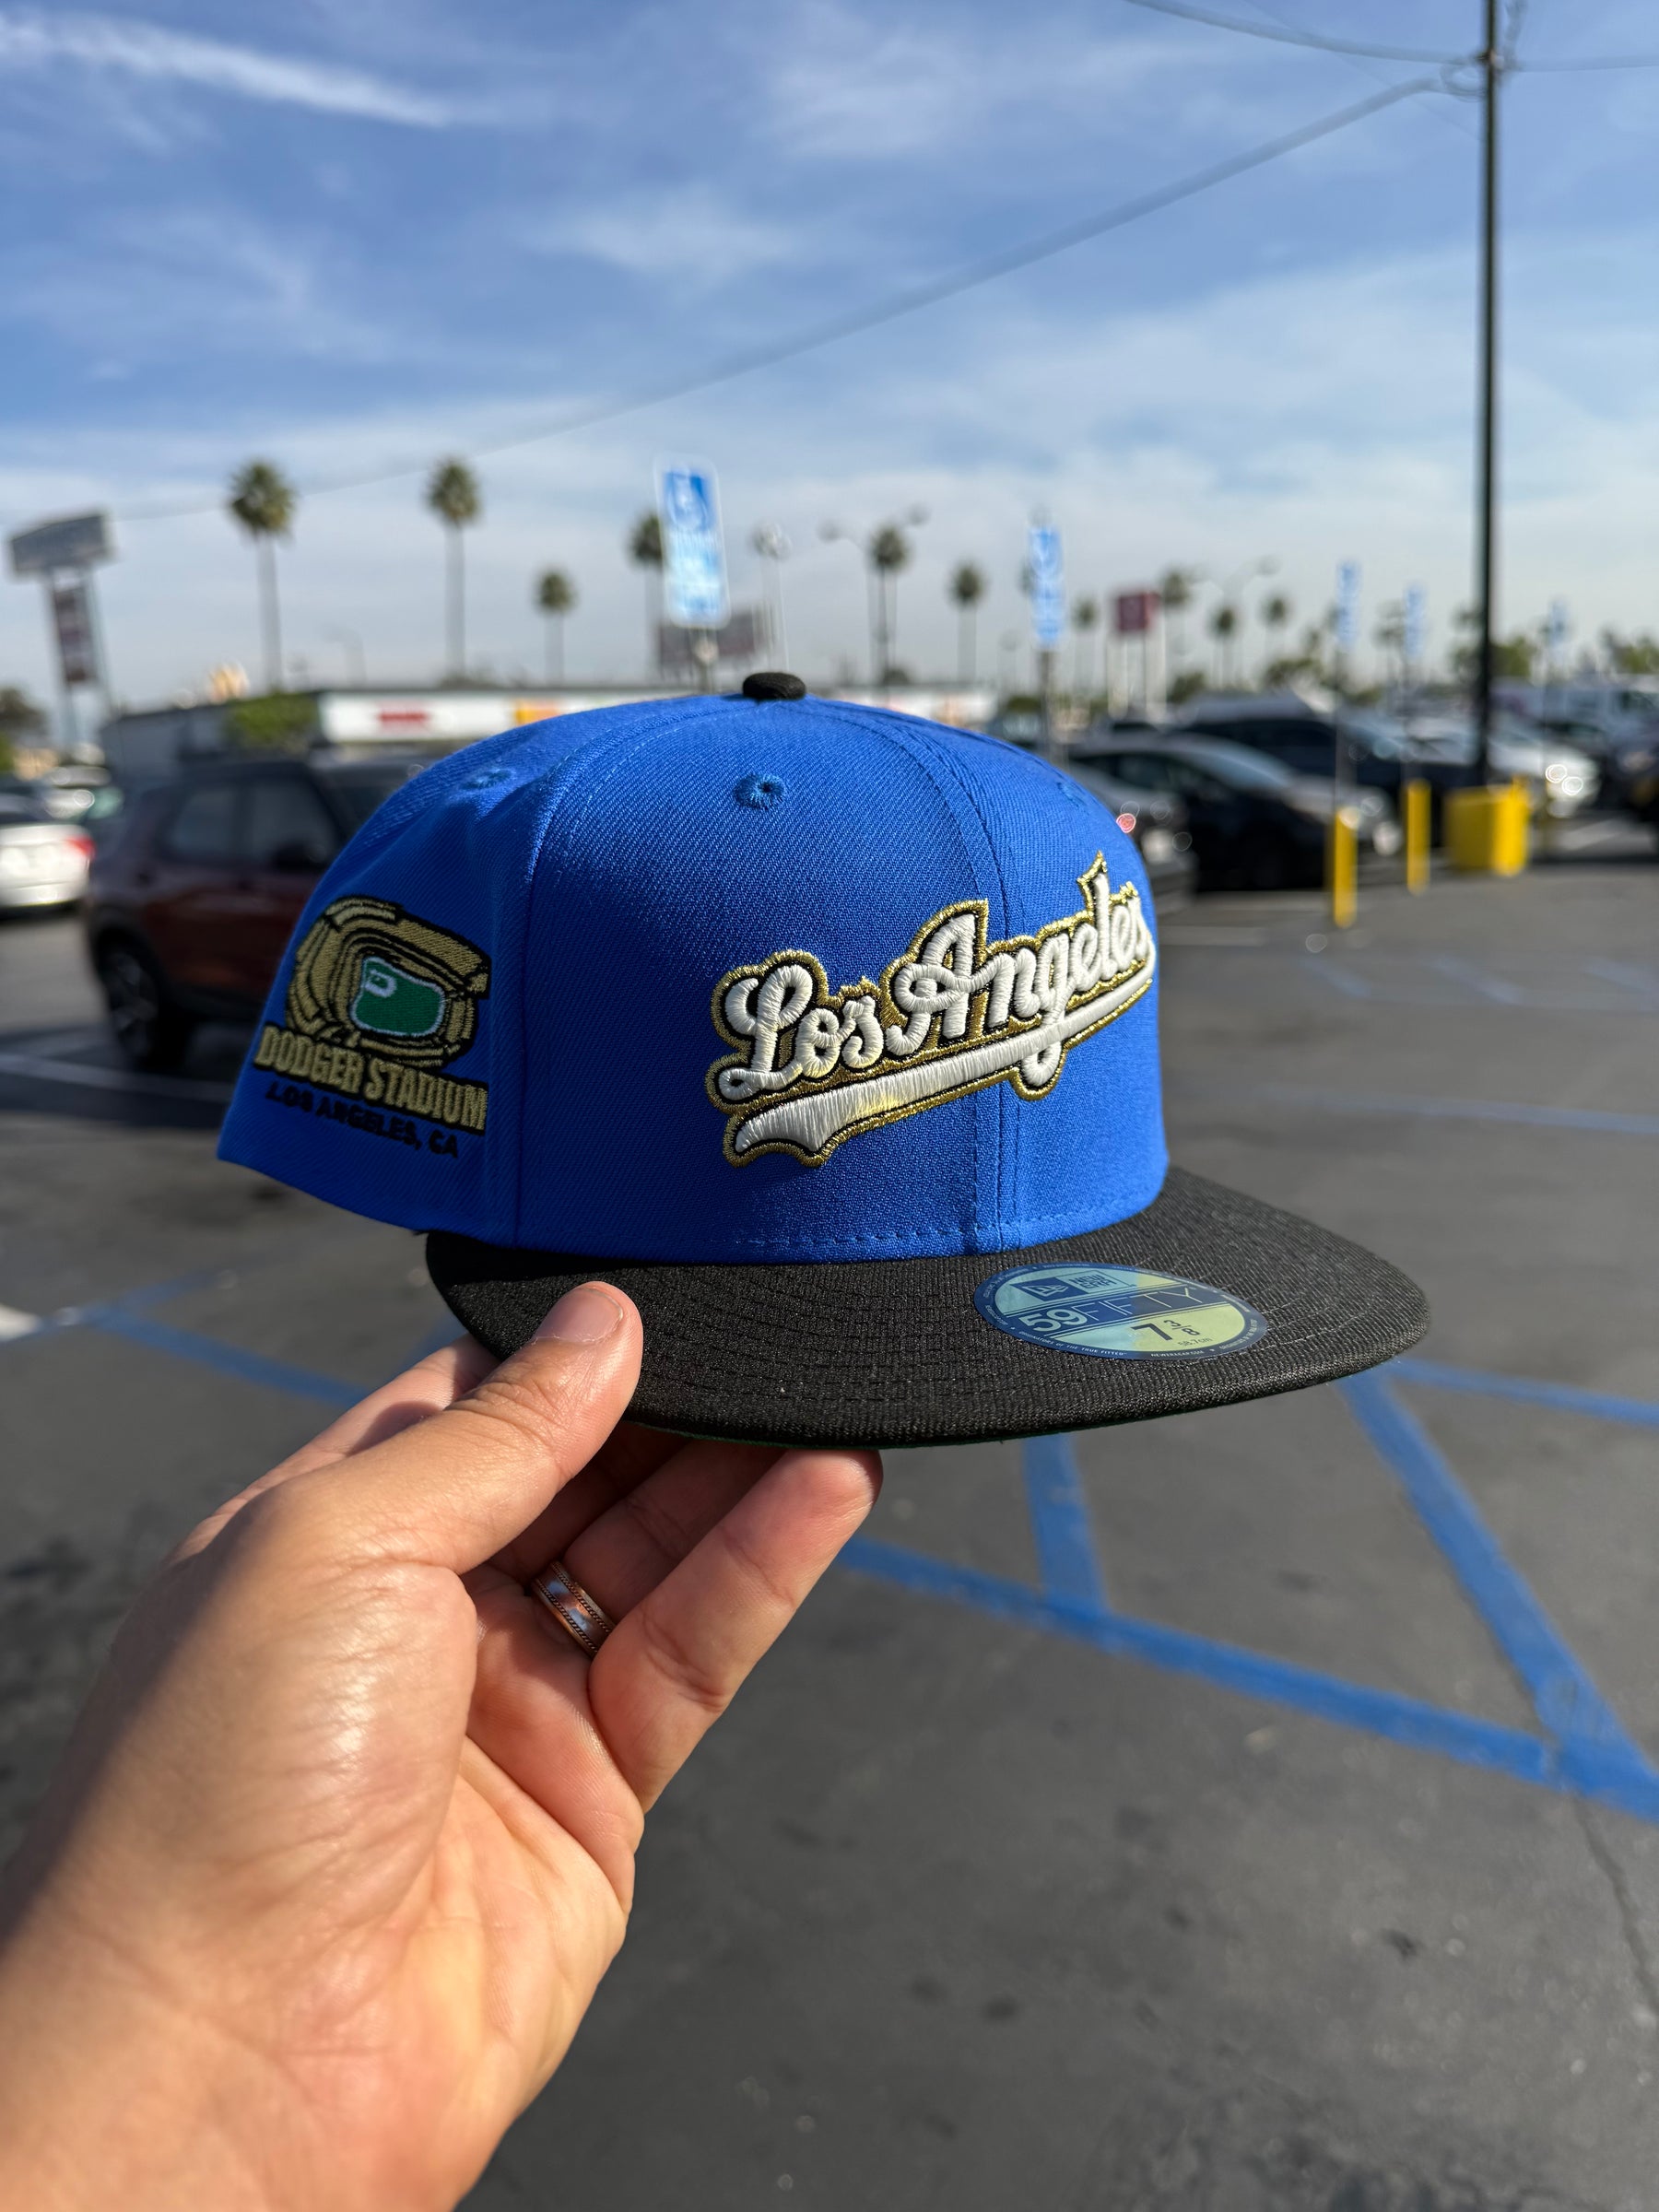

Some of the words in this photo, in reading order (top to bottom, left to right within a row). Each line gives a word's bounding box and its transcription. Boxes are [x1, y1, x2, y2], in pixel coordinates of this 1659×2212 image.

[717, 959, 887, 1102] Los
[883, 857, 1156, 1089] Angeles
[254, 1025, 365, 1095] DODGER
[363, 1058, 488, 1132] STADIUM
[265, 1081, 313, 1112] LOS
[315, 1097, 422, 1150] ANGELES,
[429, 1129, 459, 1159] CA
[1068, 1274, 1106, 1286] NEW
[1078, 1279, 1117, 1289] ERA
[1130, 1323, 1173, 1341] 7
